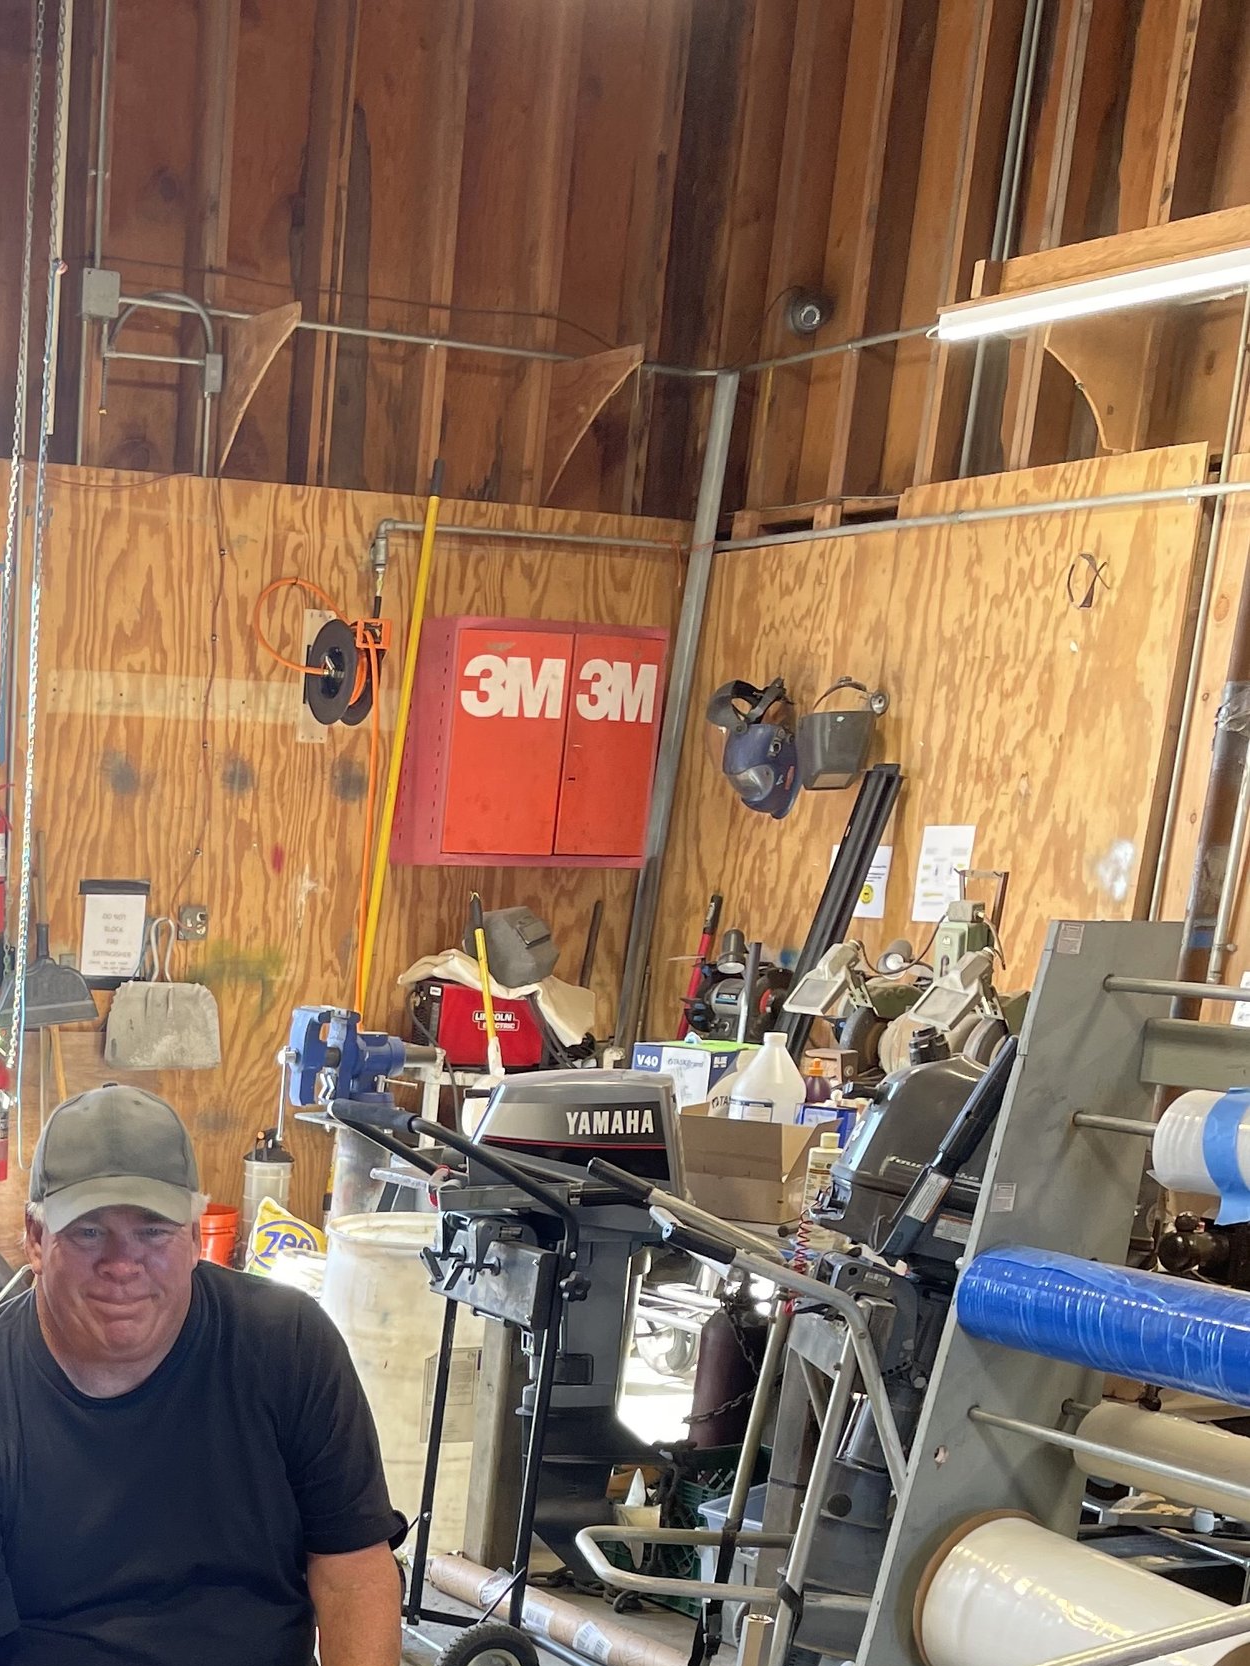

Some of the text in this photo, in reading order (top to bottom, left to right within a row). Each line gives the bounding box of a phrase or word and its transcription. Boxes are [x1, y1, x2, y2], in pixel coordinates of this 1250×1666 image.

[460, 654, 566, 719] 3M
[575, 658, 658, 724] 3M
[475, 1012, 513, 1022] LIOLN
[482, 1022, 516, 1030] ECTRIC
[636, 1054, 659, 1068] V40
[566, 1109, 654, 1136] YAMAHA
